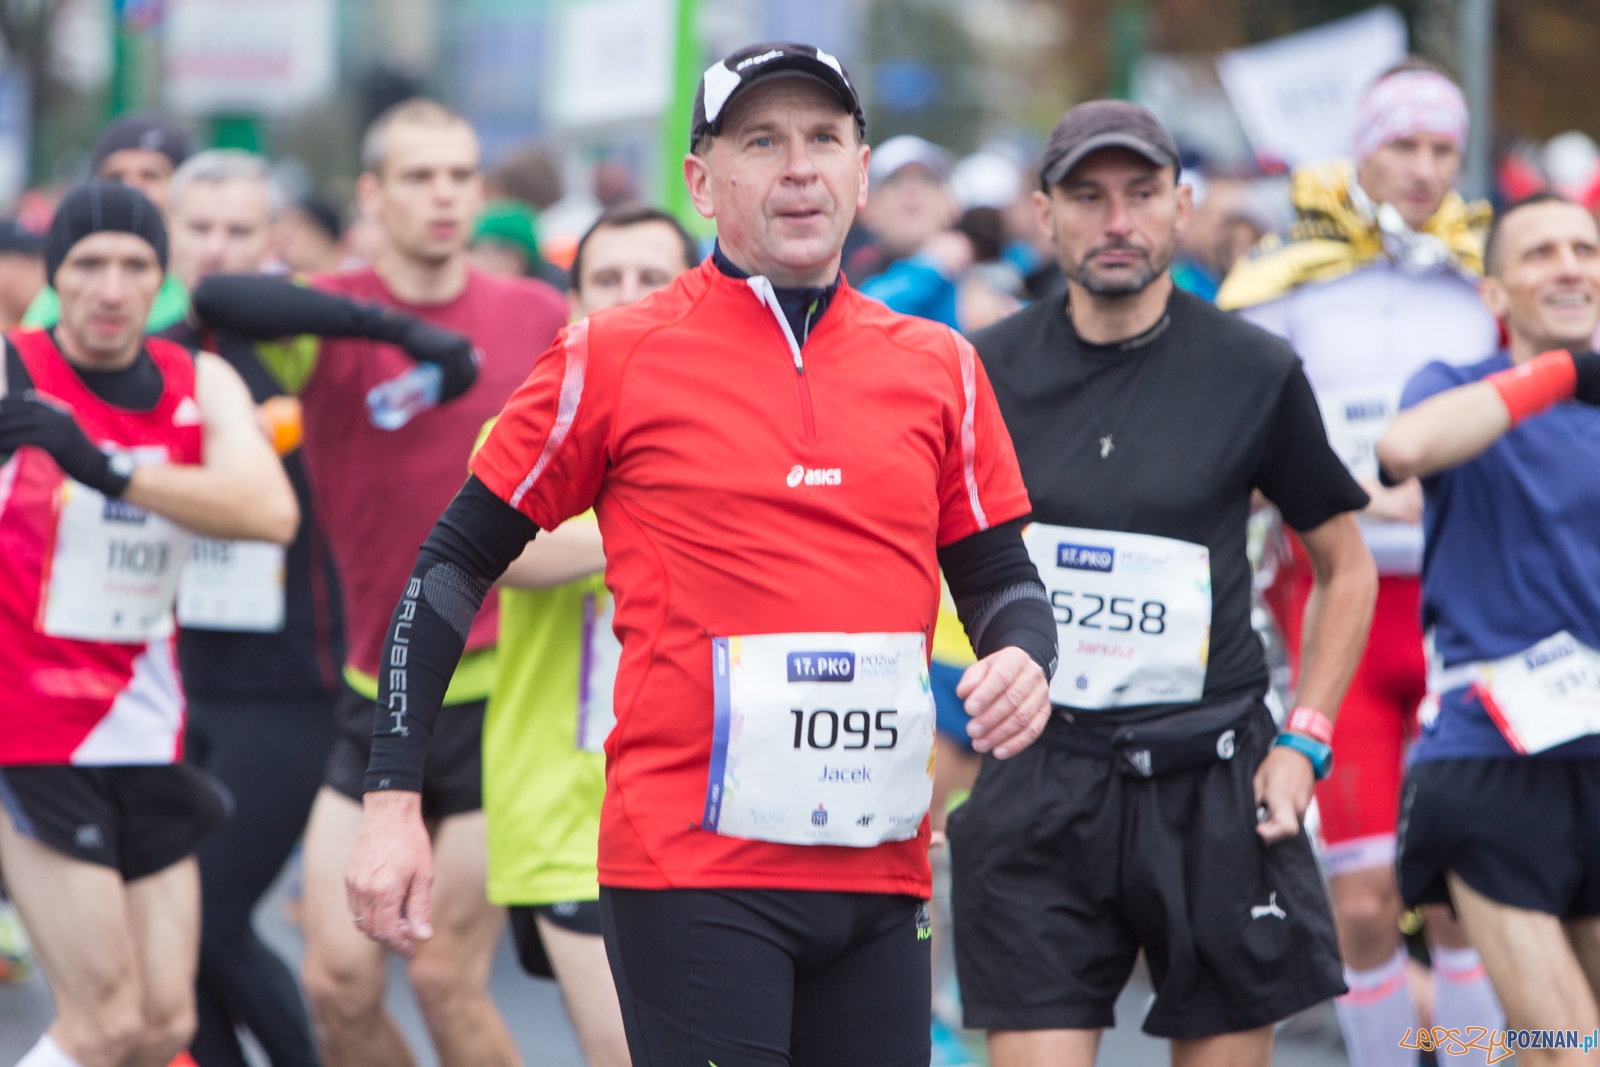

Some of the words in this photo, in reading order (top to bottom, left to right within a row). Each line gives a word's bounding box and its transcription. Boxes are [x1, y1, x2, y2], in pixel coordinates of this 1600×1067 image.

[1050, 590, 1166, 635] 5258
[388, 577, 422, 735] BRUBECK
[1076, 639, 1136, 659] Janusz
[790, 708, 899, 750] 1095
[817, 764, 873, 783] Jacek
